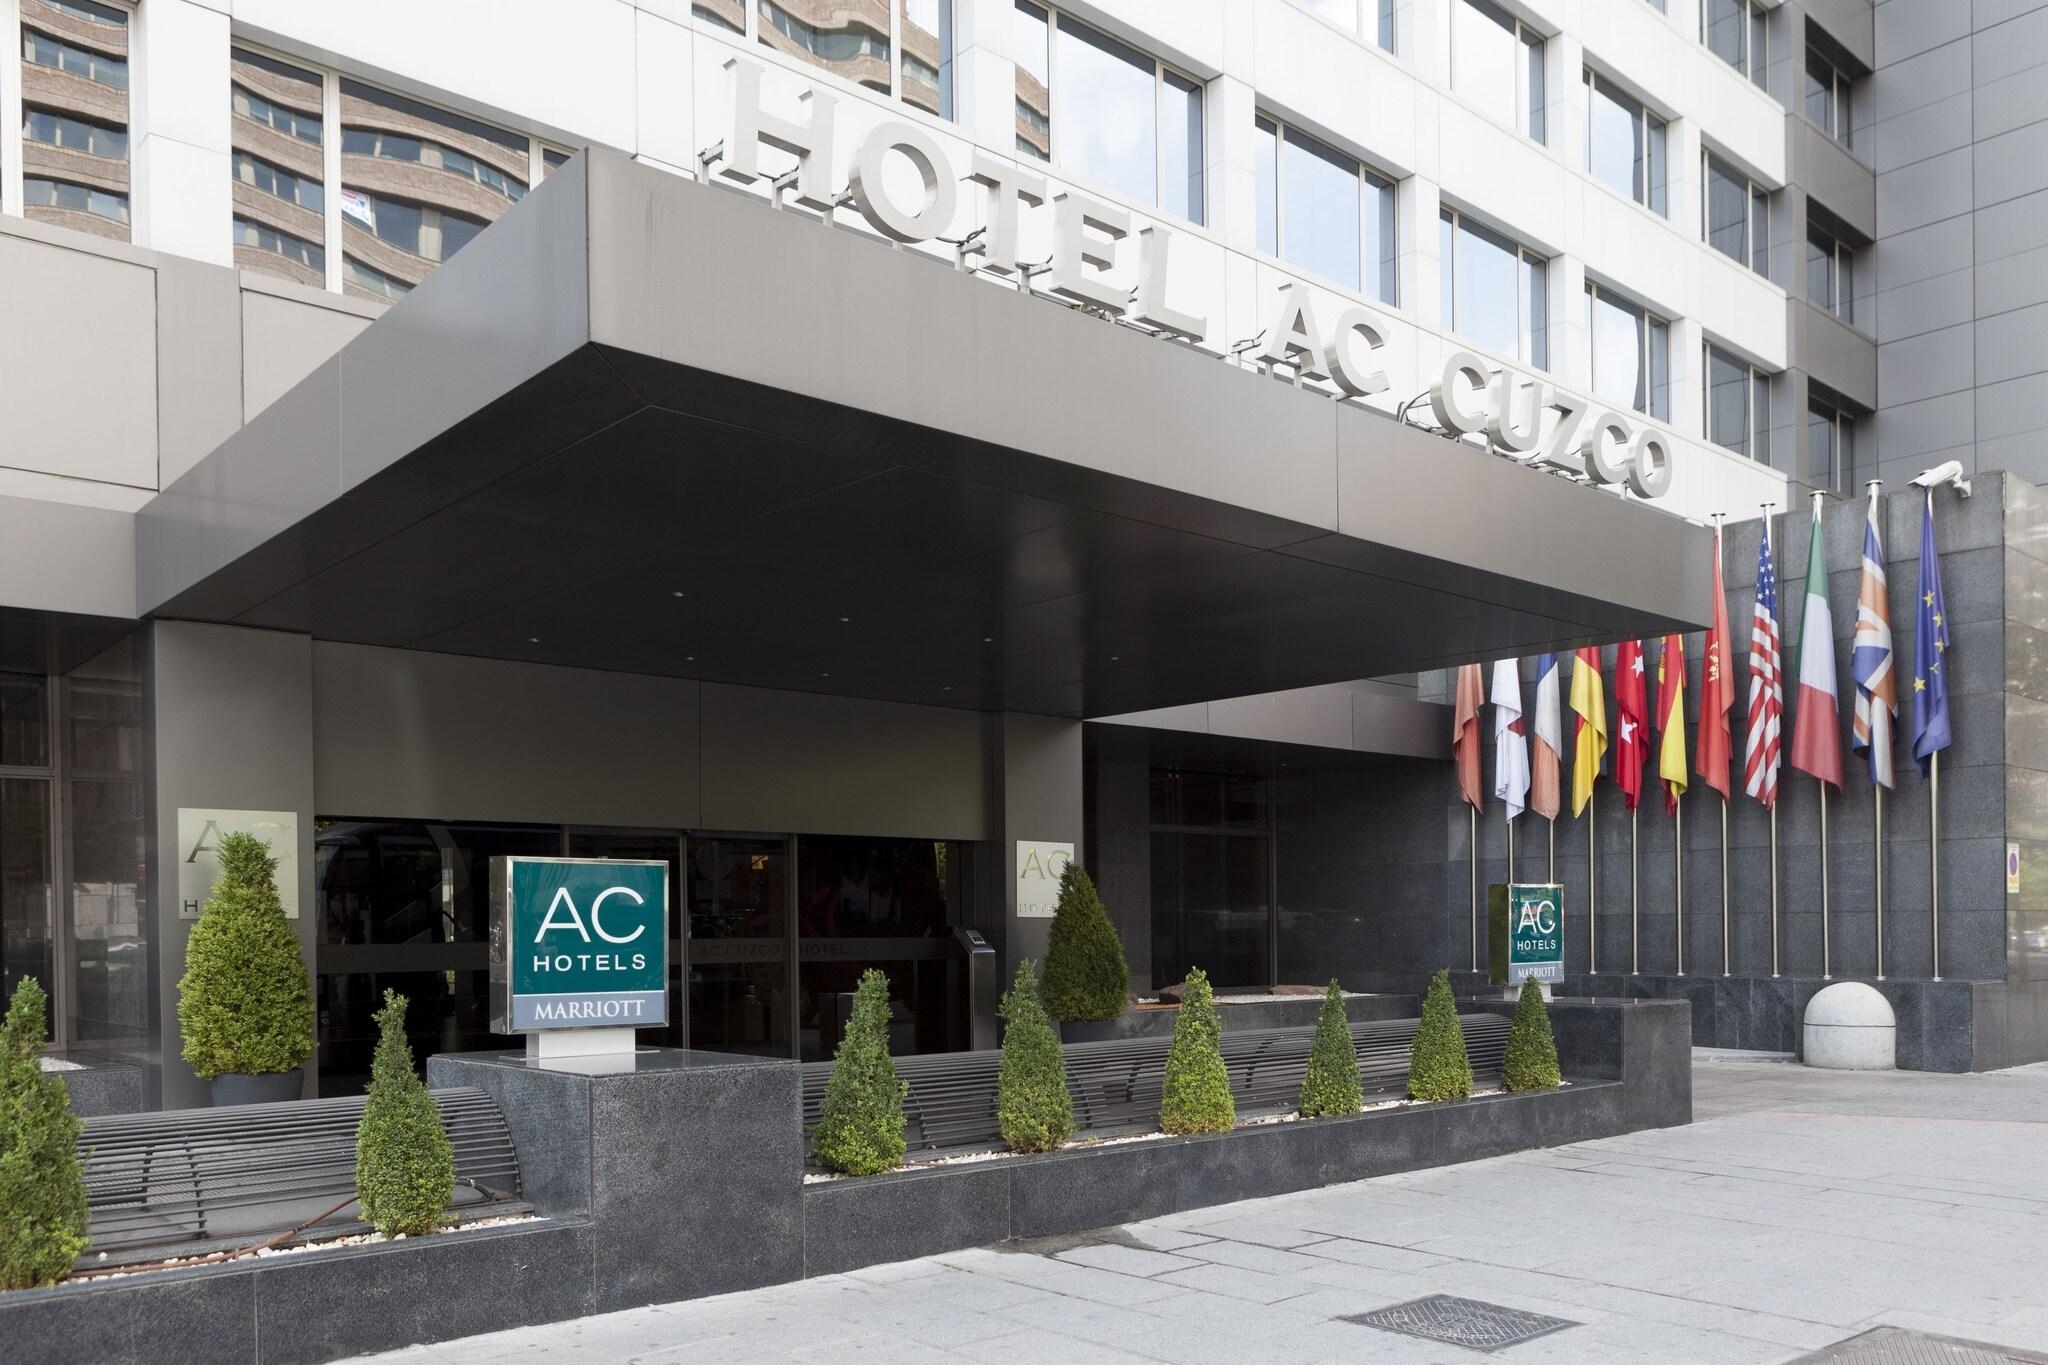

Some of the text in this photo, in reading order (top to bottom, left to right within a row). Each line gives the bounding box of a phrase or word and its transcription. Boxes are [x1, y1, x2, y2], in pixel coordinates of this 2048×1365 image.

[719, 57, 1673, 499] HOTEL AC CUZCO
[534, 886, 646, 944] AC
[1517, 900, 1556, 934] AC
[799, 943, 848, 955] HOTEL
[1517, 939, 1556, 951] HOTELS
[533, 954, 646, 972] HOTELS
[534, 1000, 646, 1020] MARRIOTT
